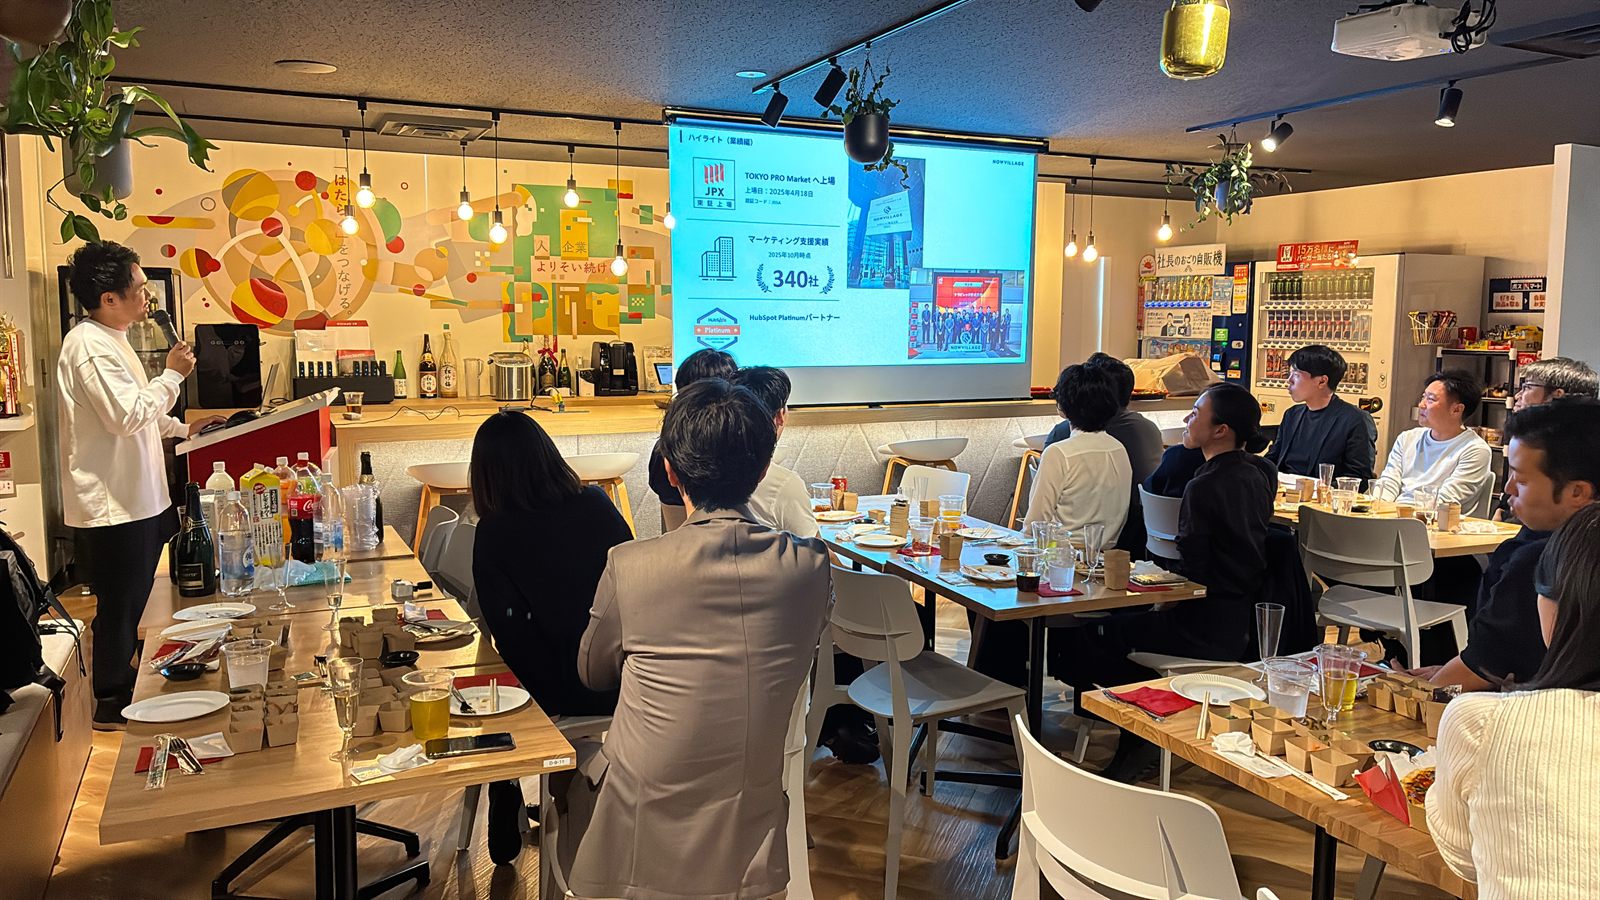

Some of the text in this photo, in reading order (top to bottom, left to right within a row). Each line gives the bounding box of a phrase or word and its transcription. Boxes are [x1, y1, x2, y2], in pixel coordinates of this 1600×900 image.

[992, 159, 1025, 167] NOWVILLAGE
[745, 172, 769, 181] TOKYO
[770, 173, 785, 182] PRO
[786, 175, 812, 184] Market
[705, 187, 725, 197] JPX
[536, 240, 587, 253] 人 企業
[748, 235, 829, 247] マーケティング支援実績
[1157, 250, 1223, 269] 社長のおごり自販機
[773, 269, 820, 288] 340社
[750, 313, 841, 322] HubSpot Platinumパートナー
[704, 326, 731, 334] Platinum
